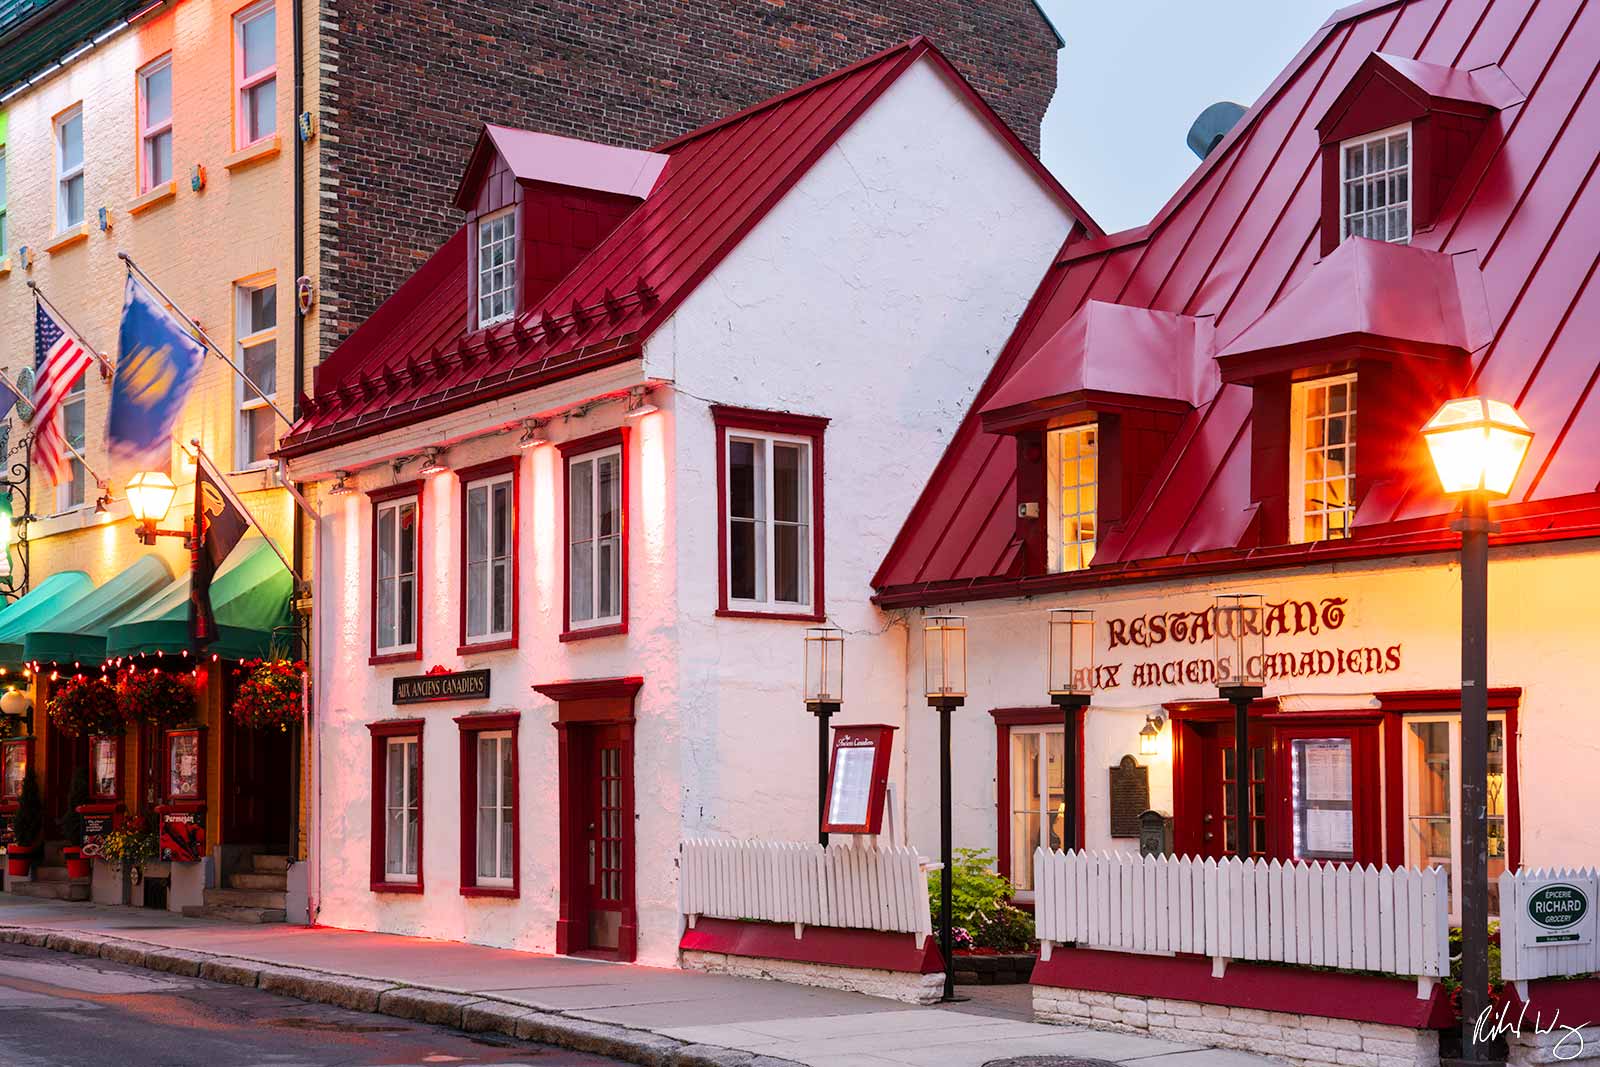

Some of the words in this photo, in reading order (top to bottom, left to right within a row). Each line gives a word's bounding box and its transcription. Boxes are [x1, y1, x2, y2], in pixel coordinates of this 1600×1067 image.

[1107, 597, 1348, 650] RESTAURANT
[1073, 663, 1122, 690] AUX
[1132, 656, 1231, 687] ANCIENS
[1246, 644, 1402, 681] CANADIENS
[398, 683, 410, 698] AUX
[412, 680, 440, 697] ANCIENS
[442, 677, 484, 694] CANADIENS
[1536, 900, 1581, 913] RICHARD
[1545, 915, 1572, 923] GROCERY
